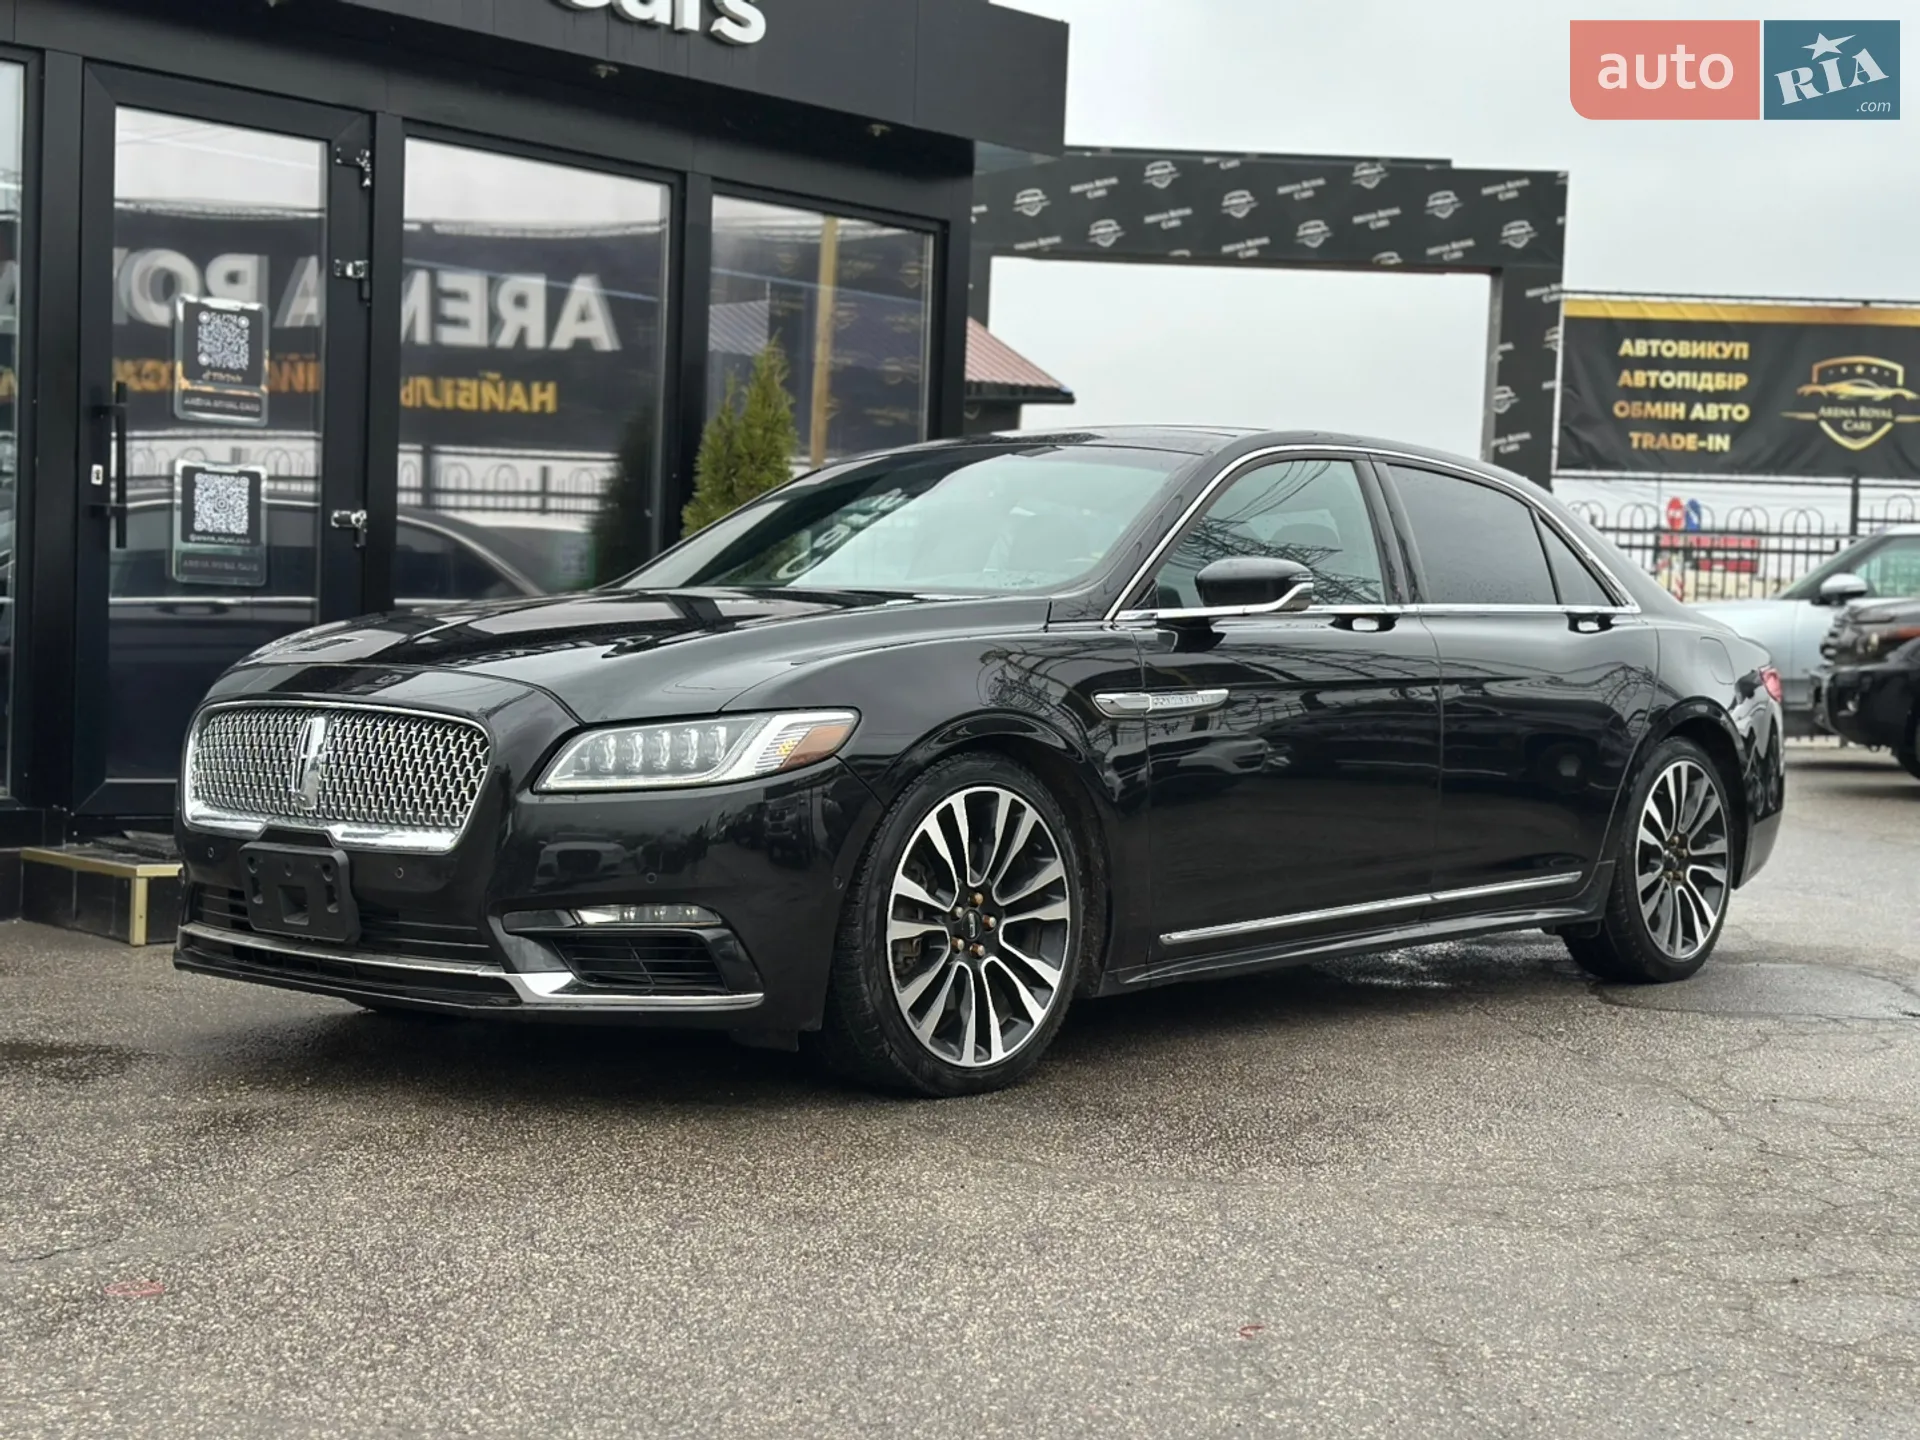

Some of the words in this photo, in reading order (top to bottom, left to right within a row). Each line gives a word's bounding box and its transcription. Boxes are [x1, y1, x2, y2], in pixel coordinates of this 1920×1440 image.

[1618, 338, 1749, 361] АВТОВИКУП
[1617, 369, 1749, 392] АВТОПІДБІР
[1613, 400, 1686, 420] ОБМІН
[1689, 402, 1750, 422] АВТО
[1629, 431, 1731, 452] TRADE-IN
